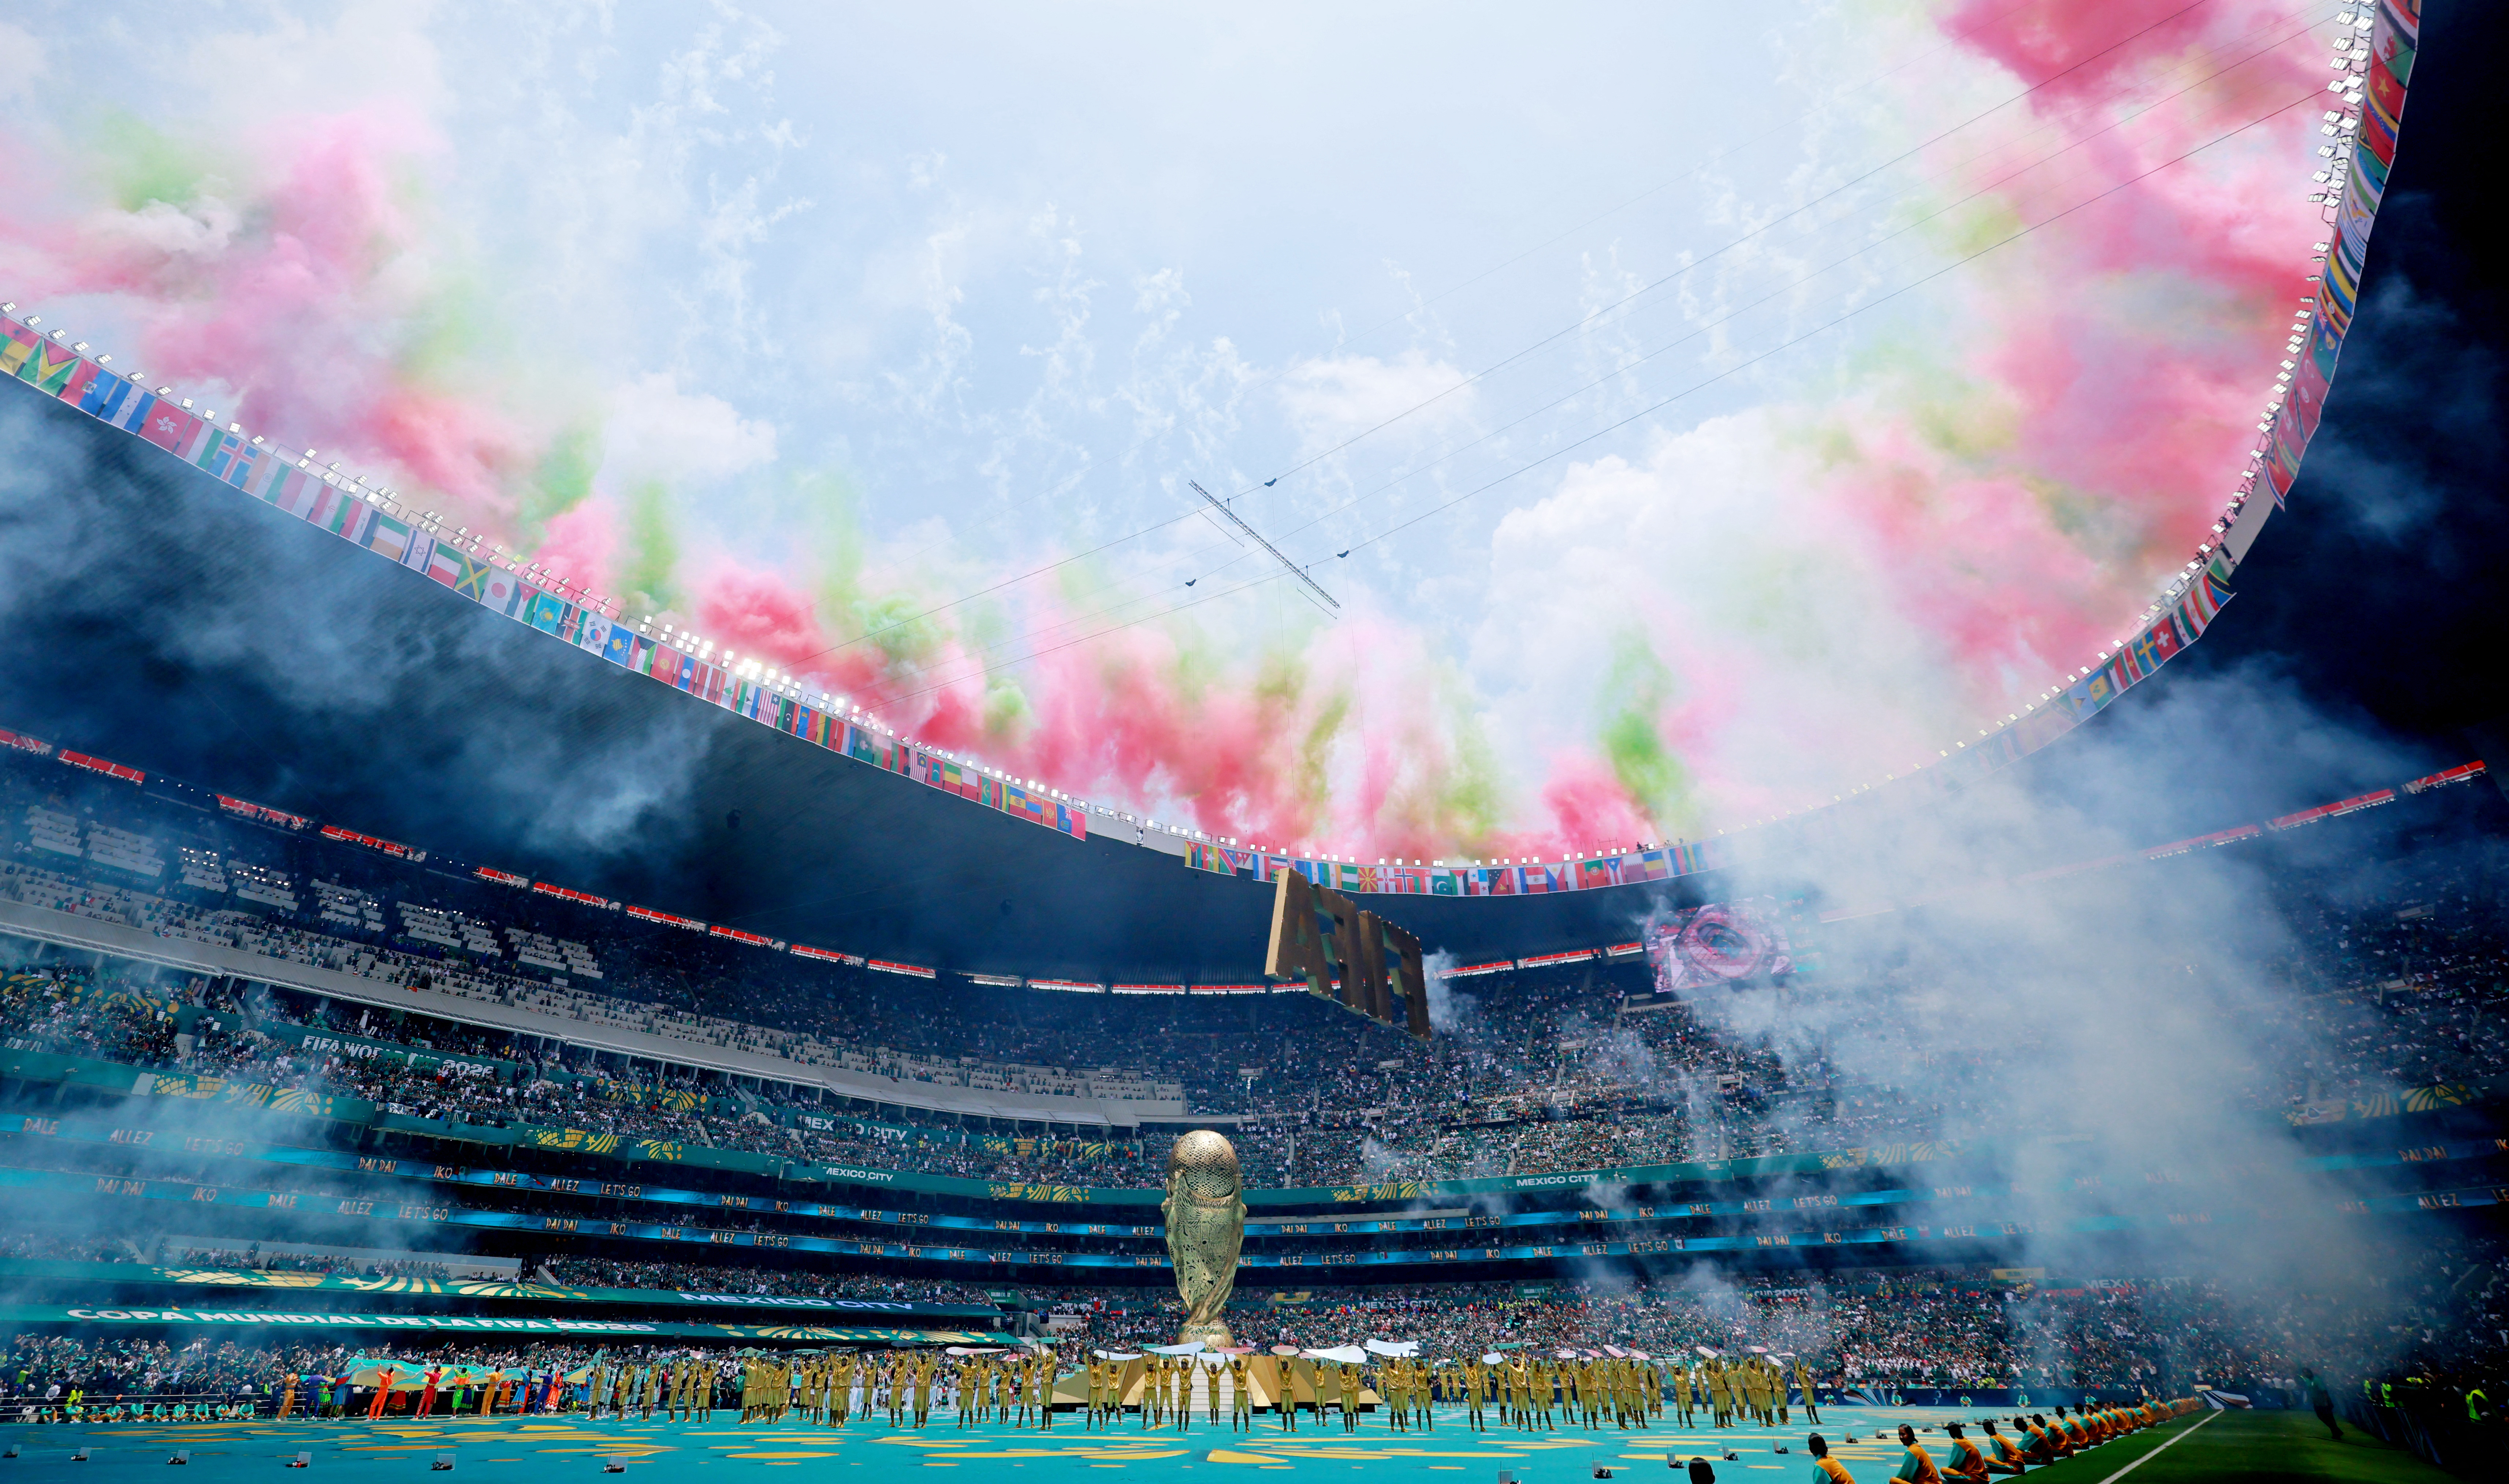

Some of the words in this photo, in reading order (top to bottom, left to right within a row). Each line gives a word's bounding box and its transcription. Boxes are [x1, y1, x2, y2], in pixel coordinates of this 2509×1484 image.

[301, 1035, 339, 1053] FIFA
[443, 1059, 496, 1077] 2026
[22, 1118, 60, 1135] DALE
[109, 1129, 154, 1145] ALLEZ
[868, 1126, 907, 1140] CITY
[226, 1142, 243, 1156] GO
[2398, 1149, 2423, 1162] DAI
[2423, 1146, 2447, 1159] DAI
[358, 1157, 377, 1171] DAI
[379, 1160, 397, 1173] DAI
[434, 1166, 452, 1178] IKO
[823, 1167, 866, 1178] MEXICO
[868, 1172, 893, 1181] CITY
[494, 1173, 517, 1185] DALE
[1516, 1175, 1567, 1187] MEXICO
[1571, 1173, 1599, 1183] CITY
[96, 1177, 121, 1194] DAI
[122, 1181, 145, 1195] DAI
[551, 1179, 579, 1191] ALLEZ
[601, 1184, 626, 1196] LET'S
[629, 1186, 640, 1197] GO
[192, 1187, 216, 1201] IKO
[268, 1194, 298, 1207] DALE
[722, 1196, 734, 1205] DAI
[736, 1197, 748, 1207] DAI
[1744, 1200, 1771, 1212] ALLEZ
[1793, 1196, 1821, 1208] LET'S
[1823, 1195, 1837, 1205] GO
[2419, 1194, 2461, 1209] ALLEZ
[337, 1199, 373, 1215] ALLEZ
[776, 1201, 788, 1212] IKO
[819, 1207, 835, 1216] DALE
[1639, 1207, 1654, 1217] IKO
[1690, 1204, 1712, 1215] DALE
[399, 1206, 430, 1219] LET'S
[433, 1209, 448, 1220] GO
[861, 1210, 881, 1220] ALLEZ
[898, 1213, 917, 1223] LET'S
[919, 1215, 928, 1224] GO
[1579, 1211, 1592, 1220] DAI
[1594, 1209, 1608, 1219] DAI
[546, 1218, 561, 1230] DAI
[563, 1220, 578, 1231] DAI
[996, 1221, 1006, 1229] DAI
[1009, 1222, 1020, 1230] DAI
[1378, 1221, 1396, 1231] DALE
[1424, 1220, 1446, 1230] ALLEZ
[1465, 1217, 1486, 1227] LET'S
[1489, 1216, 1500, 1225] GO
[610, 1223, 625, 1235] IKO
[1046, 1223, 1058, 1232] IKO
[1089, 1225, 1105, 1234] DALE
[1133, 1227, 1154, 1236] ALLEZ
[1296, 1224, 1307, 1233] DAI
[1335, 1224, 1347, 1232] IKO
[1944, 1226, 1977, 1238] ALLEZ
[662, 1228, 680, 1239] DALE
[710, 1232, 735, 1244] ALLEZ
[1824, 1233, 1841, 1243] IKO
[1881, 1228, 1907, 1241] DALE
[753, 1233, 777, 1246] LET'S
[778, 1237, 788, 1247] GO
[1757, 1237, 1772, 1246] DAI
[1774, 1236, 1789, 1245] DAI
[860, 1244, 871, 1254] DAI
[873, 1245, 883, 1254] DAI
[909, 1247, 921, 1257] IKO
[1533, 1247, 1552, 1257] DALE
[1581, 1242, 1608, 1256] ALLEZ
[1628, 1241, 1653, 1253] LET'S
[1656, 1241, 1668, 1251] GO
[949, 1250, 964, 1259] DALE
[991, 1253, 1012, 1262] LLEZ
[1030, 1254, 1049, 1263] LET'S
[1052, 1255, 1062, 1264] GO
[1321, 1254, 1342, 1264] LET'S
[1345, 1254, 1356, 1264] GO
[1431, 1252, 1443, 1260] DAI
[1445, 1251, 1457, 1259] DAI
[1486, 1249, 1500, 1258] IKO
[1136, 1257, 1147, 1266] DAI
[1150, 1258, 1161, 1266] DAI
[1239, 1257, 1252, 1266] ALE
[1280, 1256, 1302, 1266] ALLEZ
[1775, 1288, 1809, 1297] 2026
[678, 1294, 832, 1306] MEXICO
[835, 1301, 913, 1310] CITY
[67, 1309, 194, 1321] COPA
[194, 1312, 375, 1325] MUNDIAL
[375, 1317, 428, 1327] DE
[426, 1318, 478, 1328] LA
[477, 1320, 551, 1329] FIFA
[552, 1321, 657, 1332] 2026
